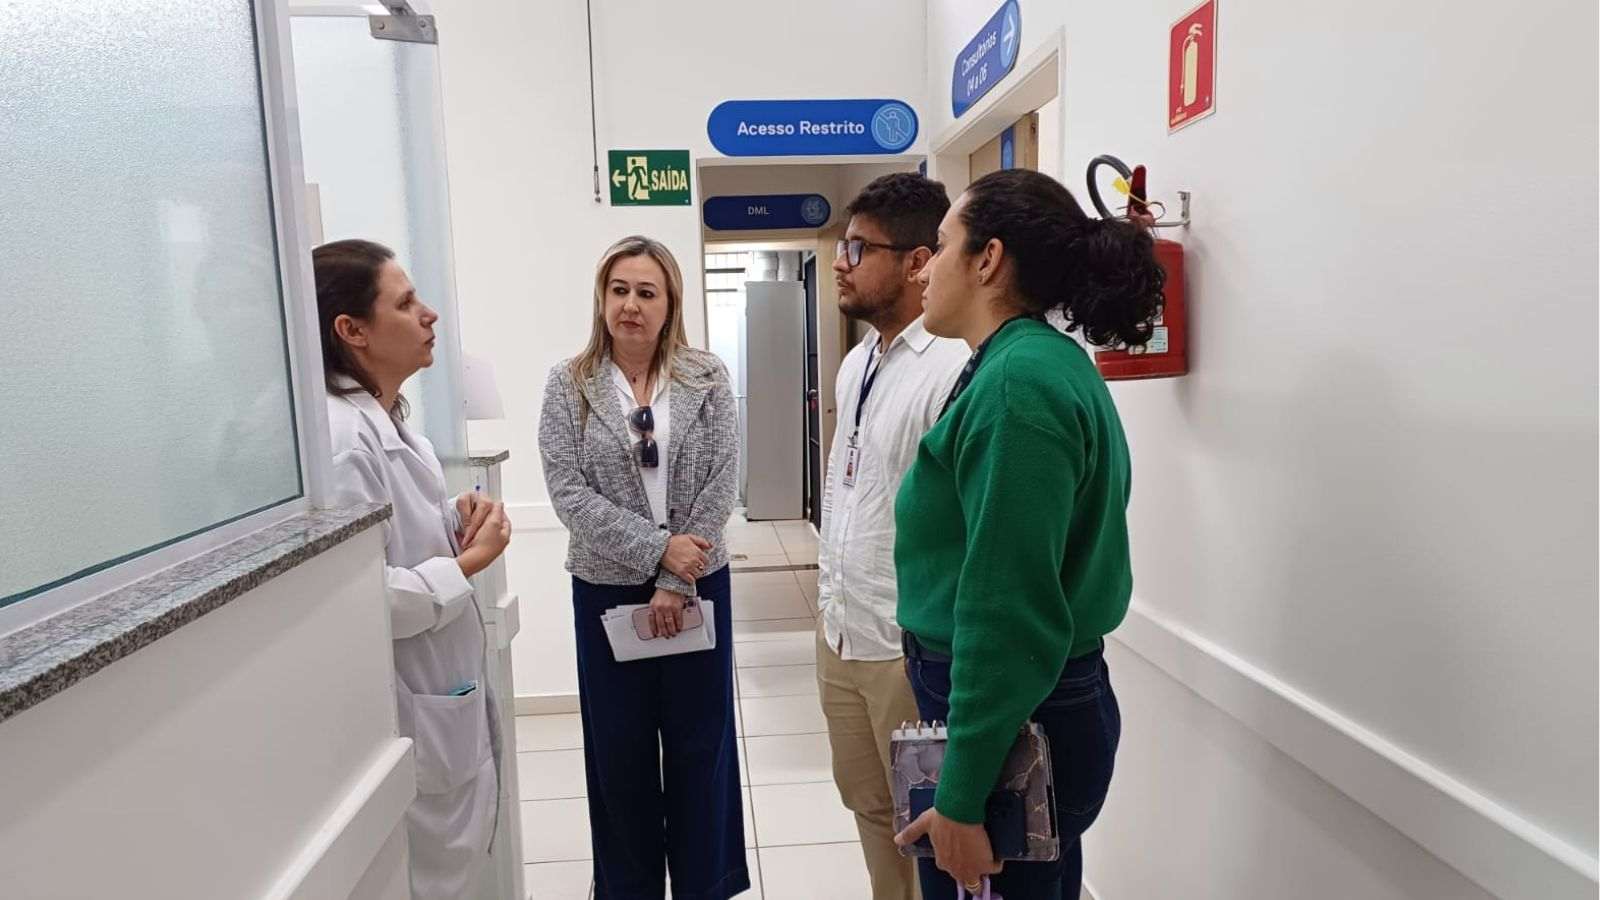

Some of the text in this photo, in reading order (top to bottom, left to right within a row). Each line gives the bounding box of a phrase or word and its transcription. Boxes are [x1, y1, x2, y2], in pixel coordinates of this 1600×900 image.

[737, 119, 865, 136] Acesso Restrito
[651, 165, 688, 191] SAÍDA
[747, 205, 771, 215] DML
